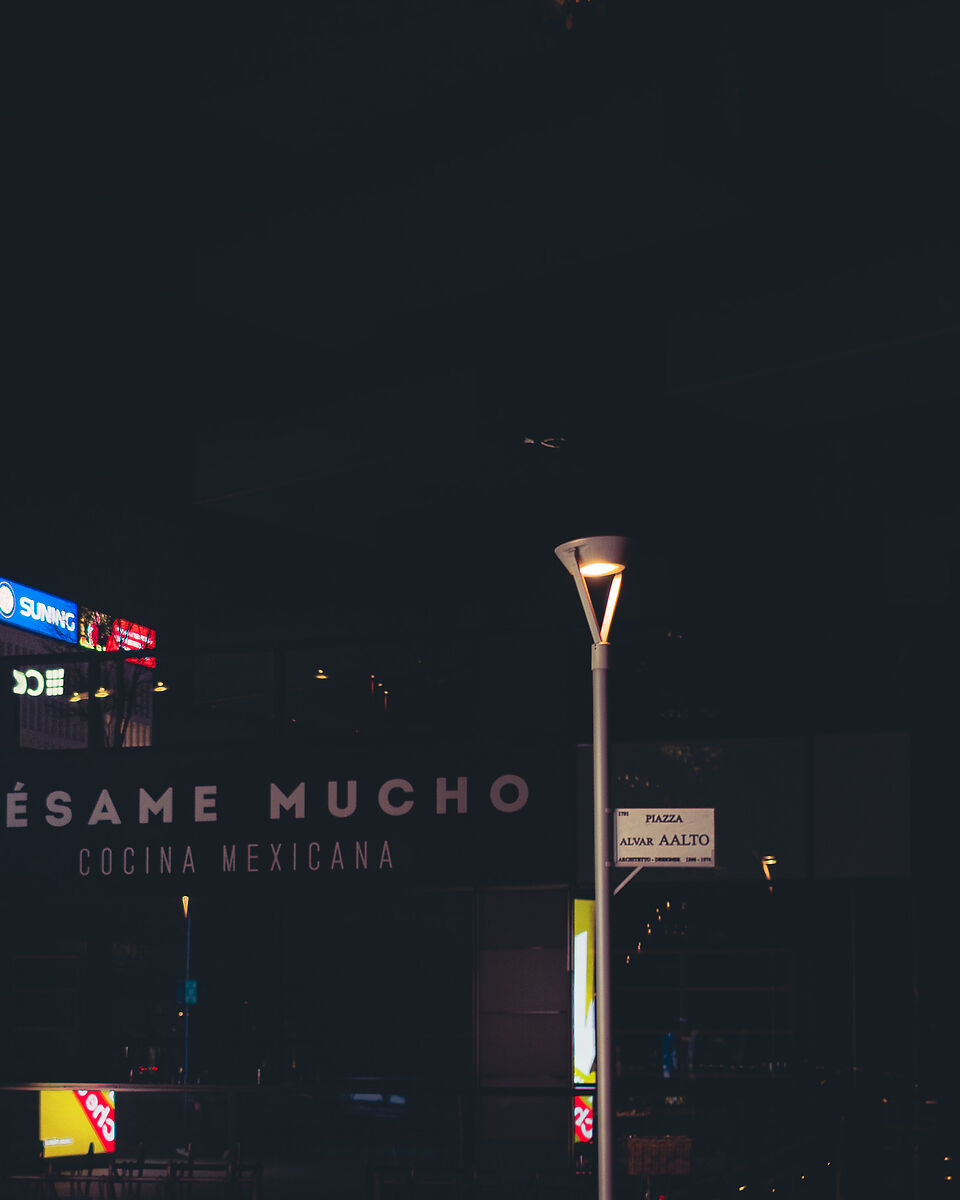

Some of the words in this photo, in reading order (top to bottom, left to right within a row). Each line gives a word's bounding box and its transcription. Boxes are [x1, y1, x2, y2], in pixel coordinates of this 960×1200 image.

[20, 596, 75, 631] SUNING
[270, 774, 529, 820] MUCHO
[645, 814, 684, 824] PIAZZA
[620, 837, 654, 846] ALVAR
[659, 833, 710, 846] AALTO
[79, 846, 196, 876] COCINA
[222, 840, 394, 873] MEXICANA
